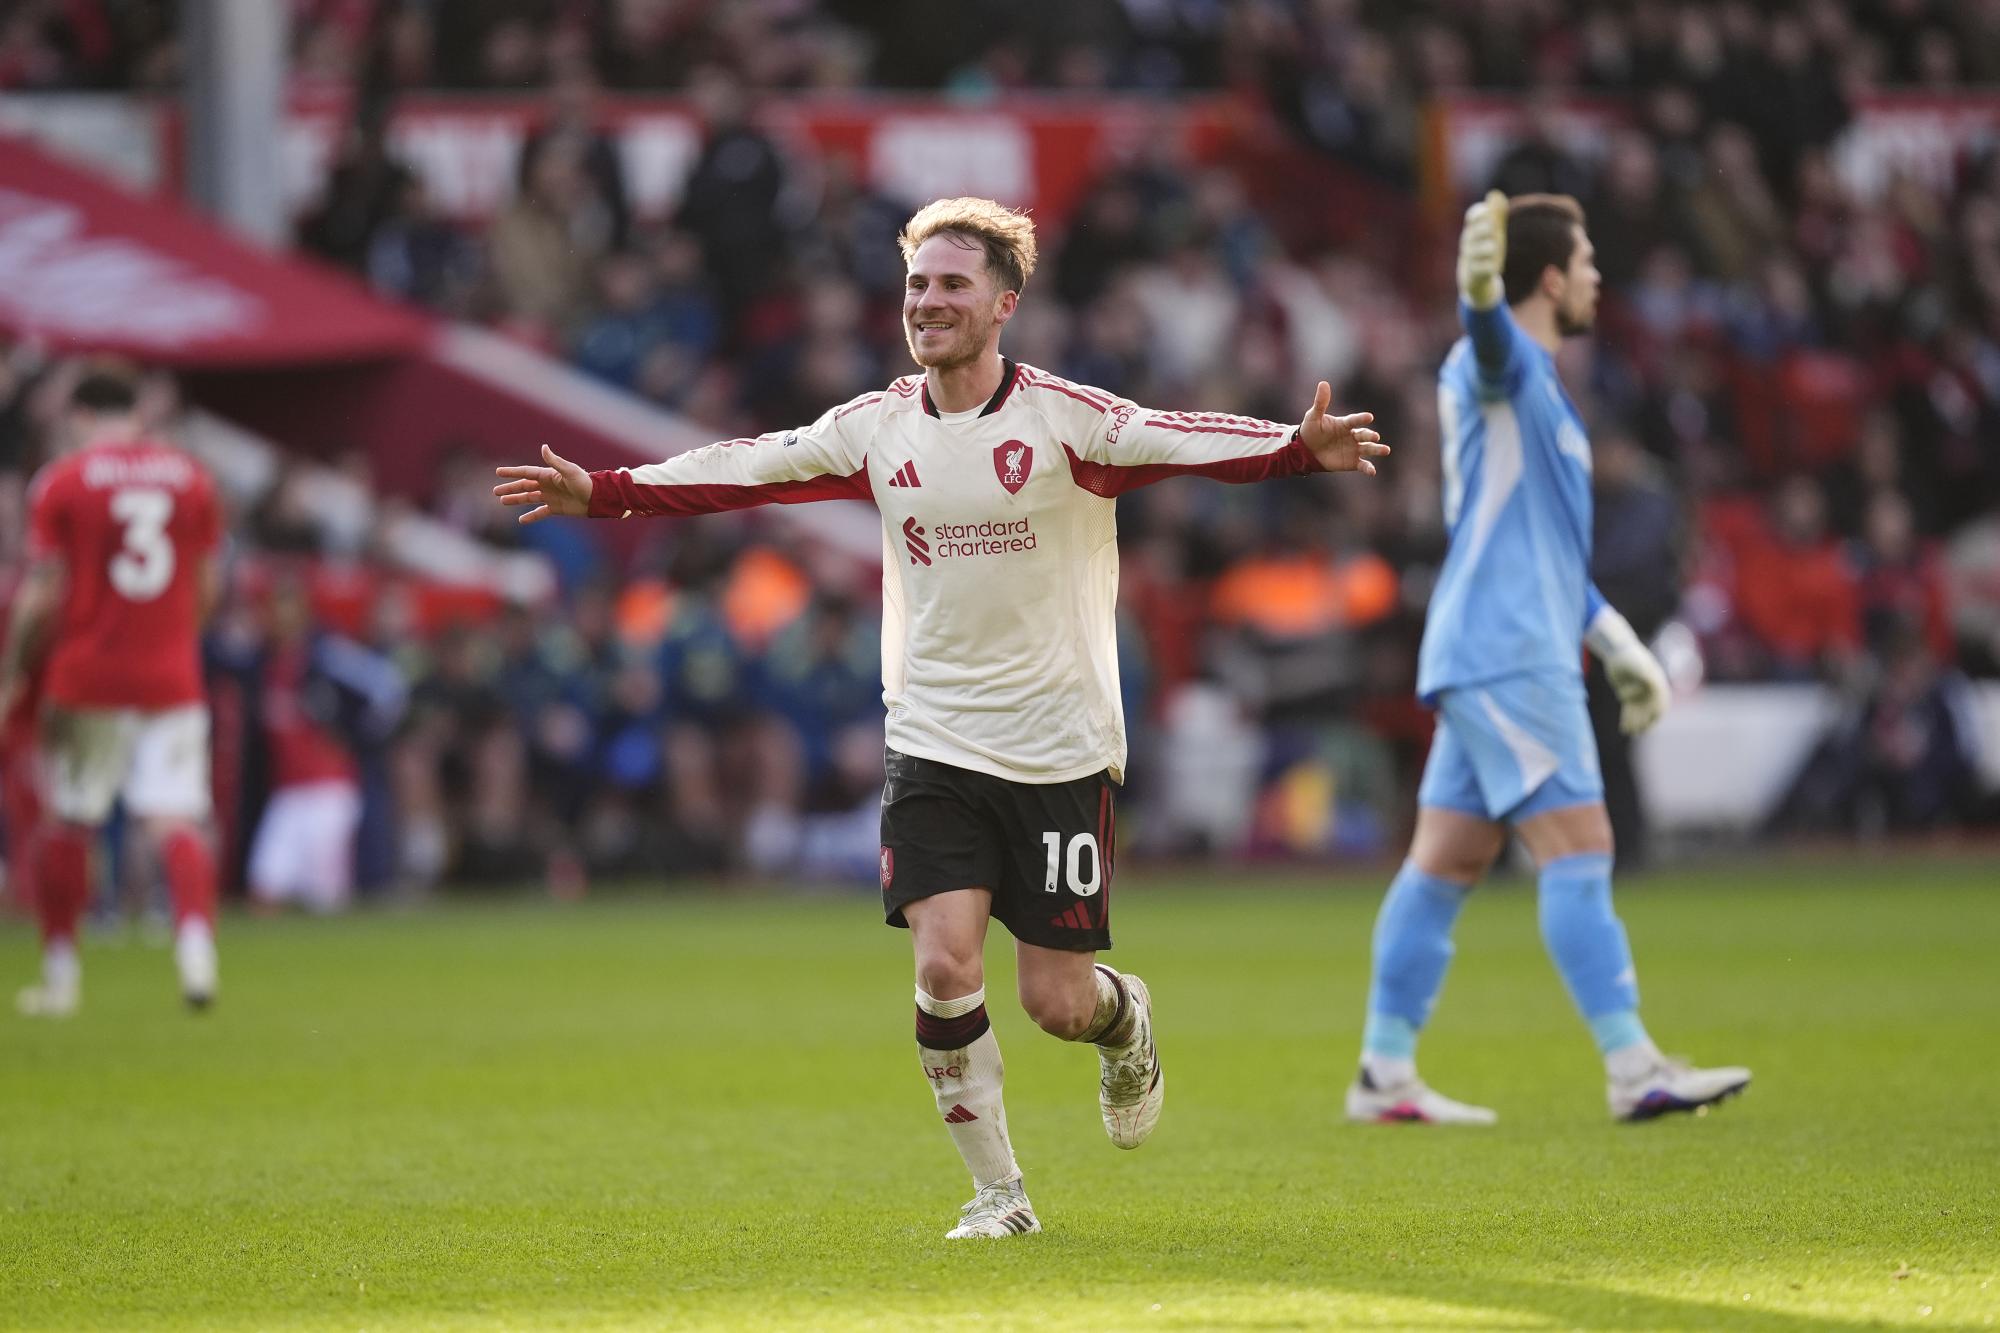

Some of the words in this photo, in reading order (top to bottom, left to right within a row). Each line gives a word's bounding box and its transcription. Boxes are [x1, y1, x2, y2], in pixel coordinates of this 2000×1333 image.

[935, 517, 1029, 540] standard
[108, 488, 176, 602] 3
[938, 533, 1037, 558] chartered
[1042, 831, 1101, 897] 10
[923, 1065, 962, 1080] LFC
